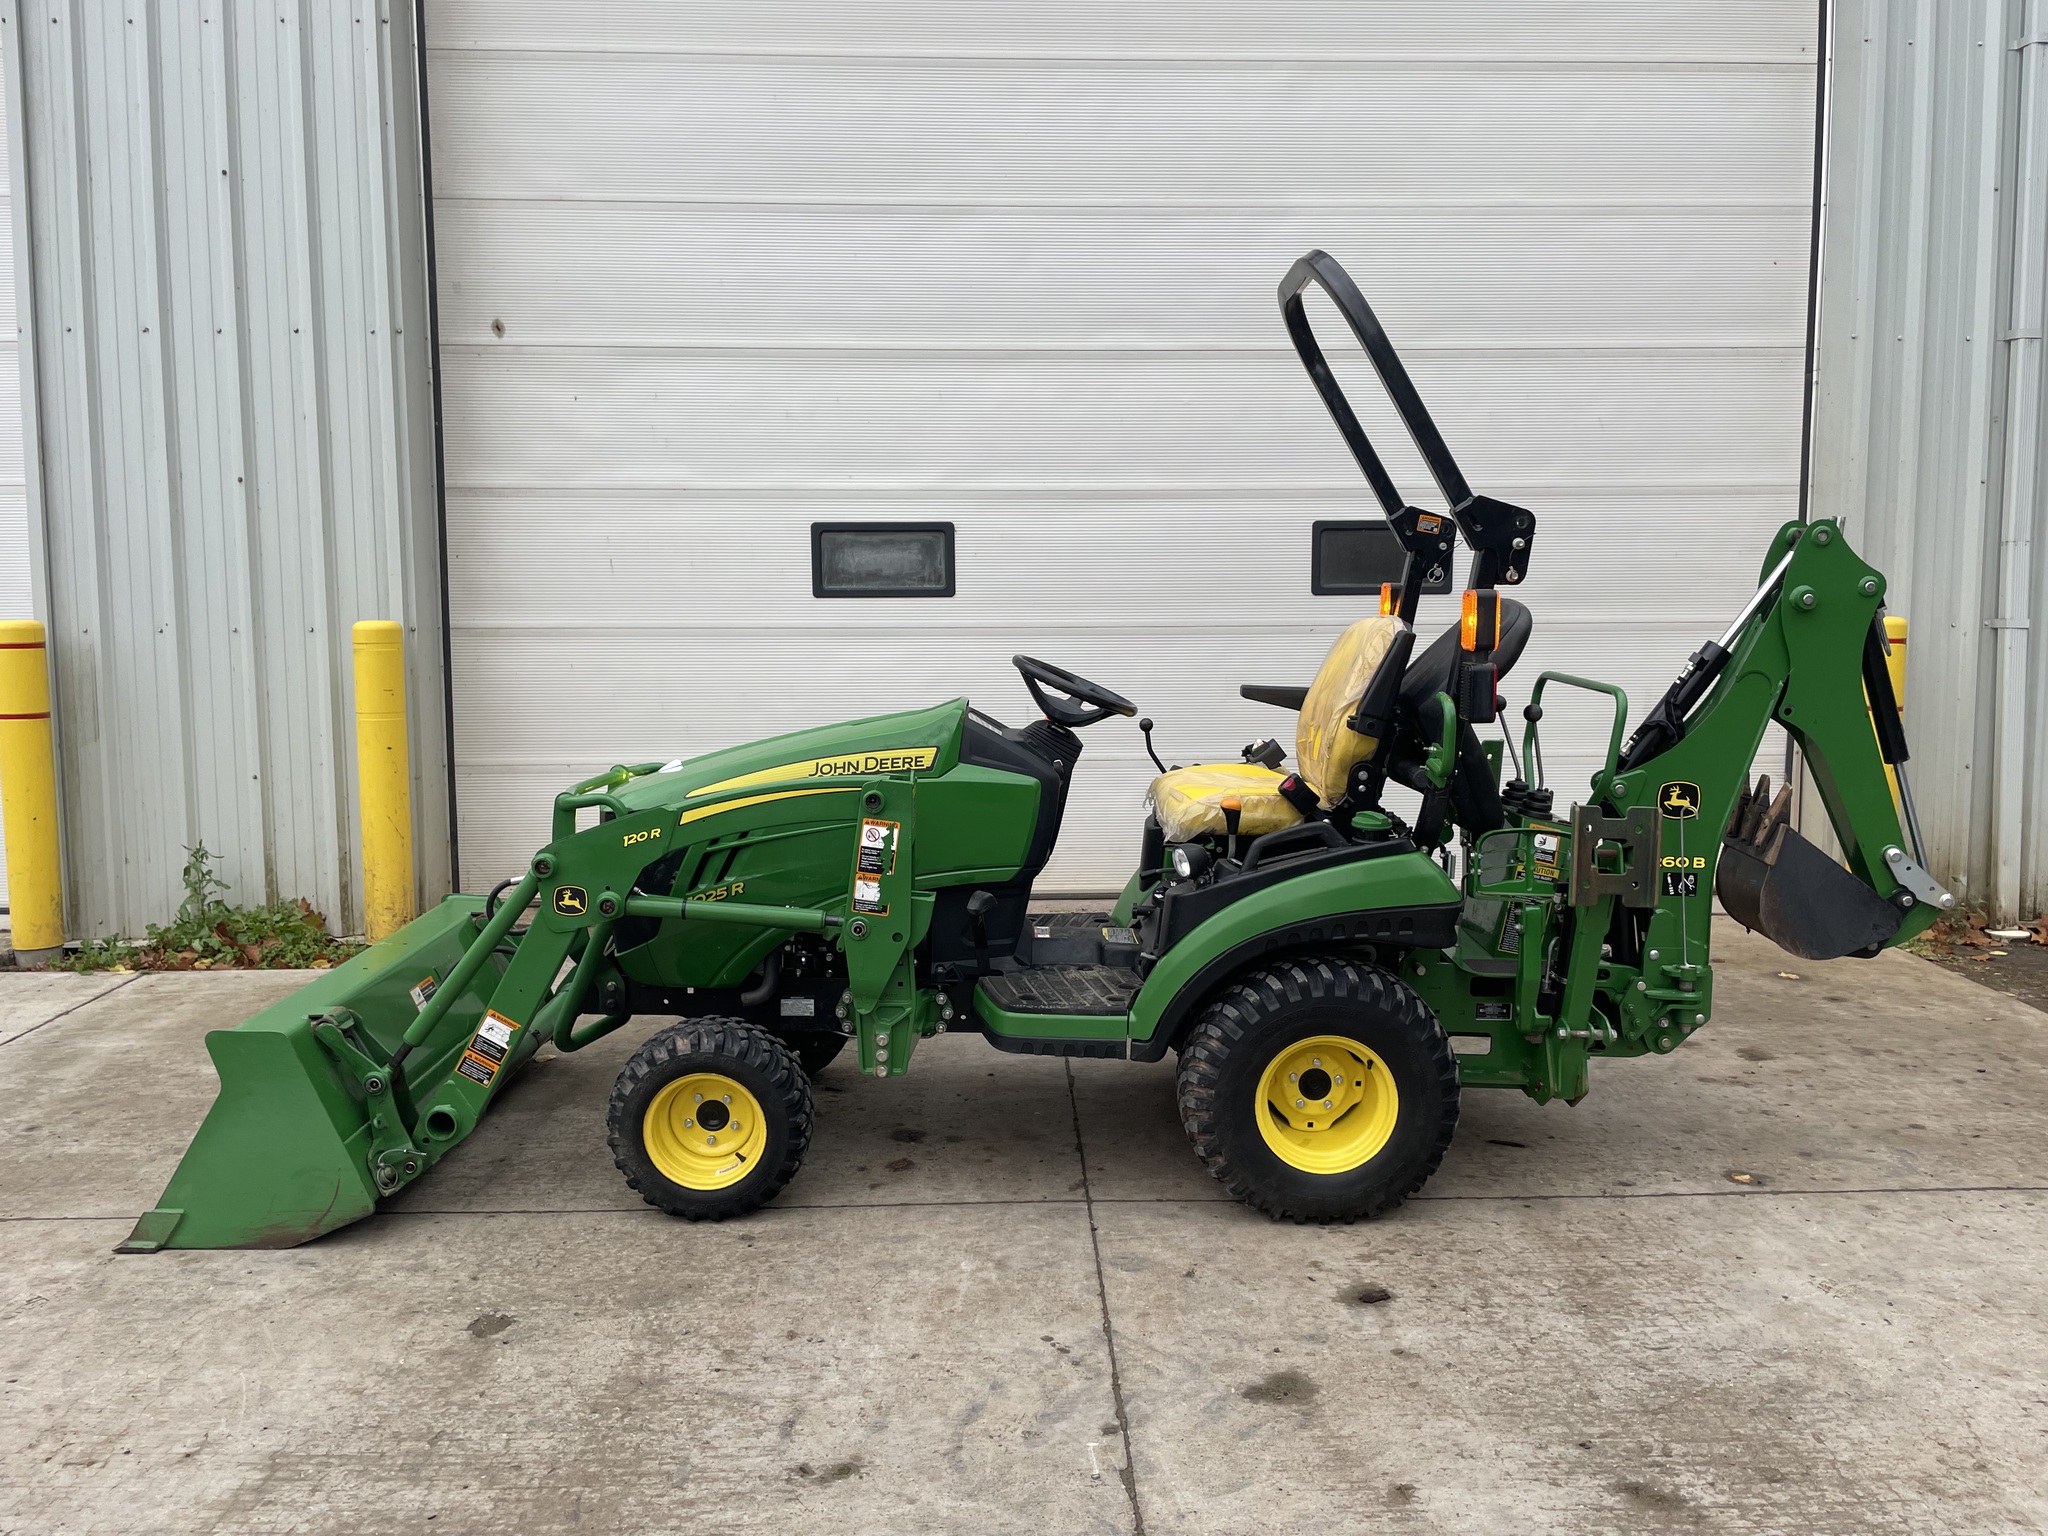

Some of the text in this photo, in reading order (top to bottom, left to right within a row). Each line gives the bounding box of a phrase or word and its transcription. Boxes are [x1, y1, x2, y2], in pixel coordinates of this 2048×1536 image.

[808, 755, 925, 777] JOHN DEERE
[869, 820, 898, 829] WARNIG
[622, 828, 661, 847] 120 R
[1659, 856, 1706, 869] 60 B
[1535, 867, 1555, 877] UTION
[731, 882, 744, 896] R
